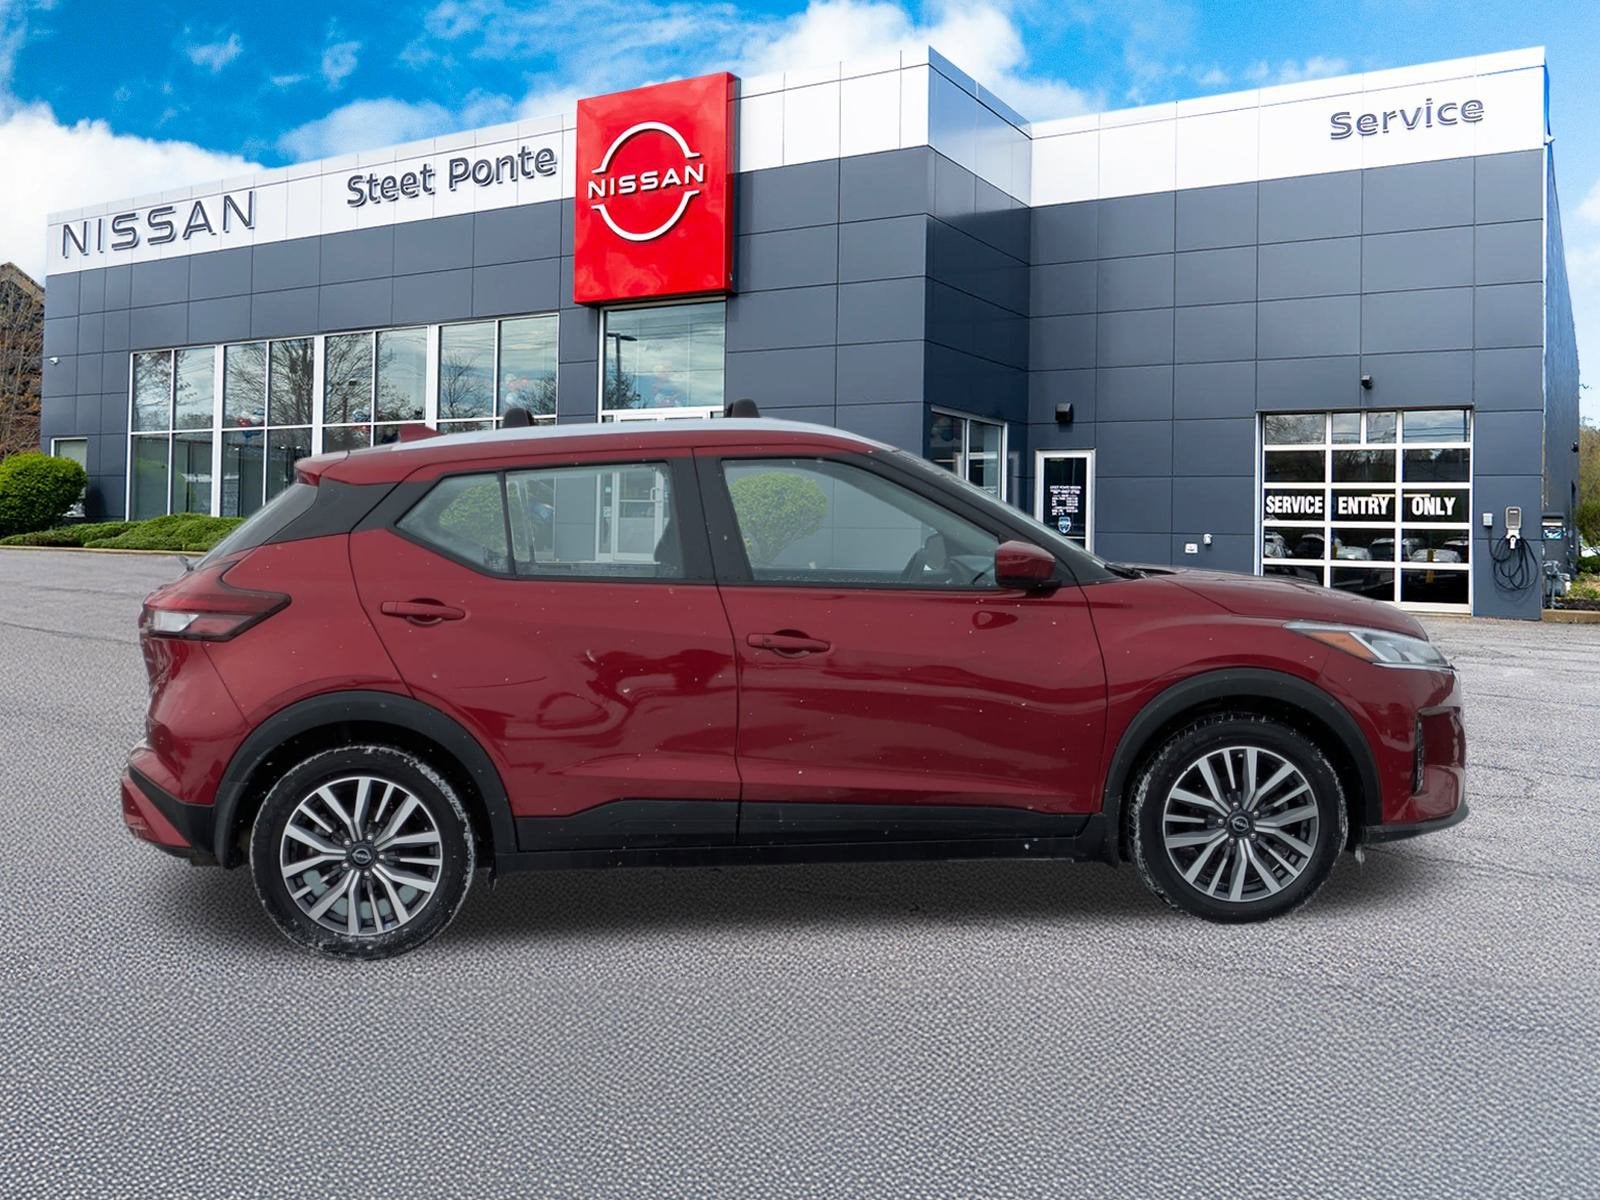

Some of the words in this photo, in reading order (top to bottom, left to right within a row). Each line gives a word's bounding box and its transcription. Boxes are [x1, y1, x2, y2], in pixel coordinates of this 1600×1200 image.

[1330, 98, 1485, 140] Service
[346, 164, 436, 208] Steet
[448, 146, 558, 190] Ponte
[588, 163, 706, 200] NISSAN
[61, 190, 256, 258] NISSAN
[1265, 495, 1323, 514] SERVICE
[1337, 496, 1390, 515] ENTRY
[1411, 496, 1456, 516] ONLY
